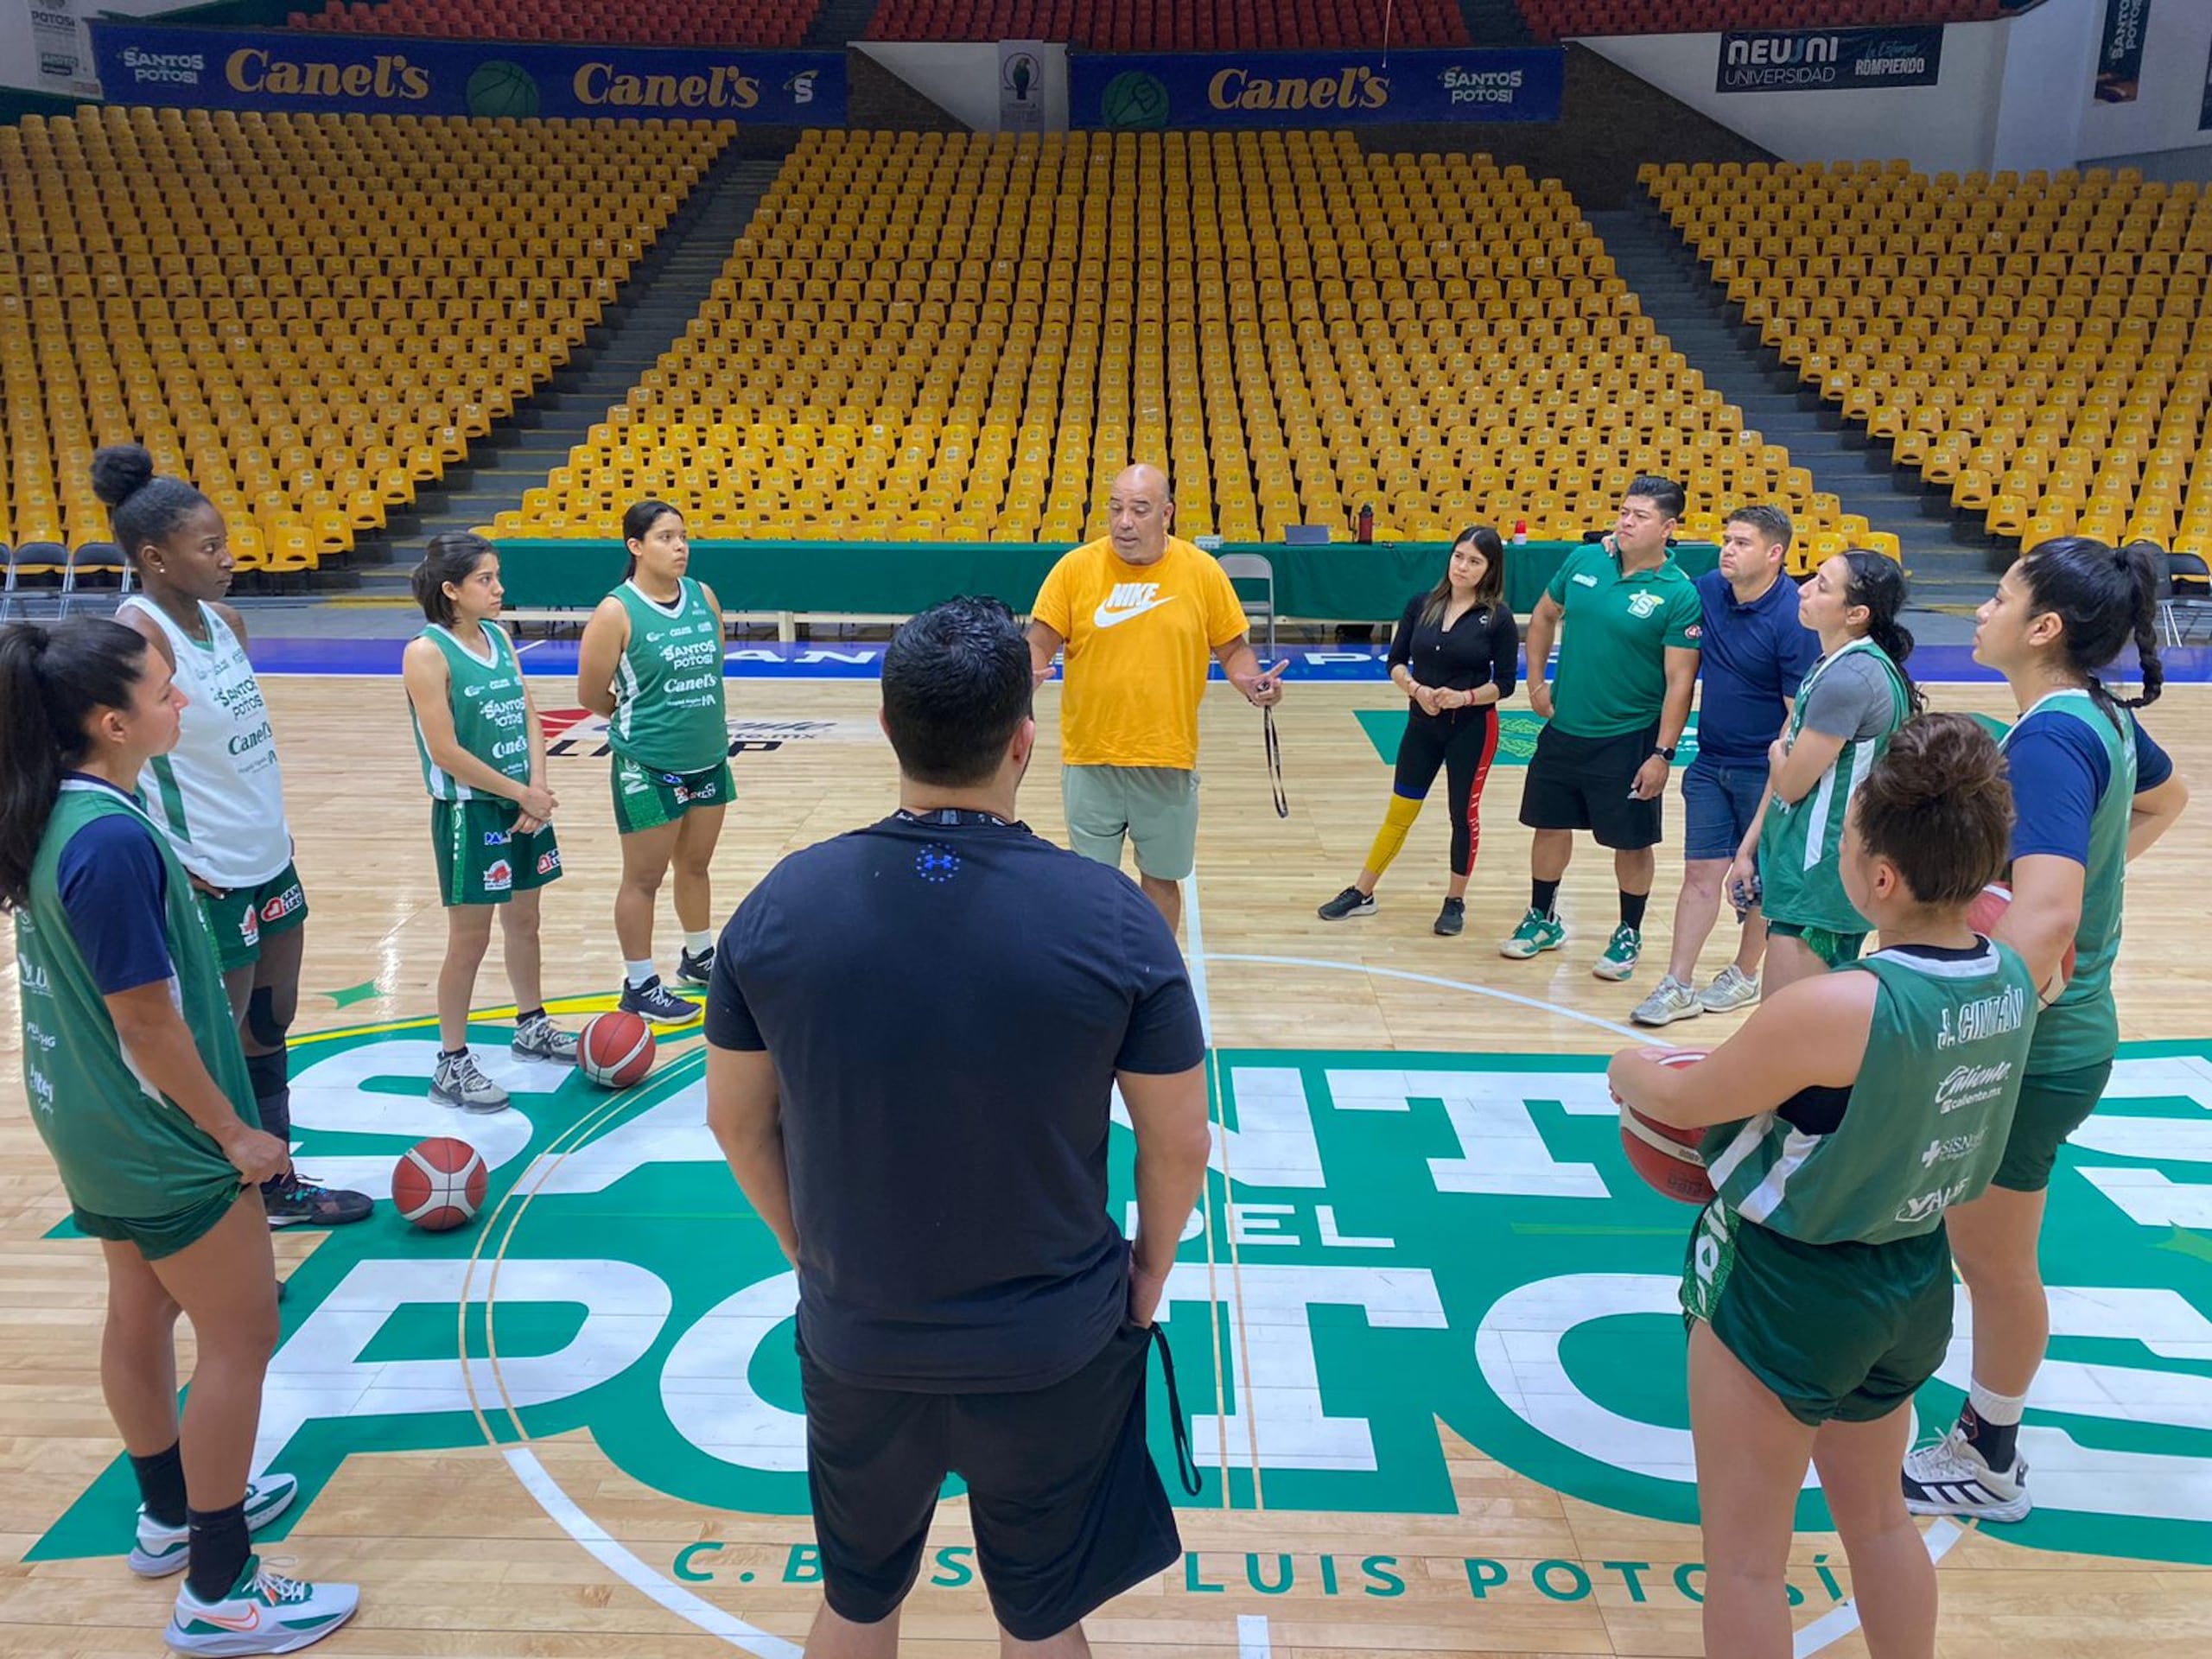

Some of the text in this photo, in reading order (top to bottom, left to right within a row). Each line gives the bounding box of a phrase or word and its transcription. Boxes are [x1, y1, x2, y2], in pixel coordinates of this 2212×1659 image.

[124, 51, 205, 70] SANTOS
[1854, 57, 1926, 76] ROMPIENDO
[135, 69, 200, 85] POTOSI
[225, 48, 430, 99] Canel's
[1443, 69, 1523, 88] SANTOS
[1725, 67, 1836, 85] UNIVERSIDAD
[572, 61, 760, 109] Canel's
[1207, 65, 1391, 111] Canel's
[1451, 88, 1514, 105] POTOSI
[1104, 582, 1161, 609] NIKE
[662, 640, 716, 662] SANTOS
[663, 672, 718, 694] Canel's
[1936, 1007, 1955, 1050] J.
[1935, 1061, 2012, 1104] Caliente
[1185, 1552, 1408, 1598] LUIS
